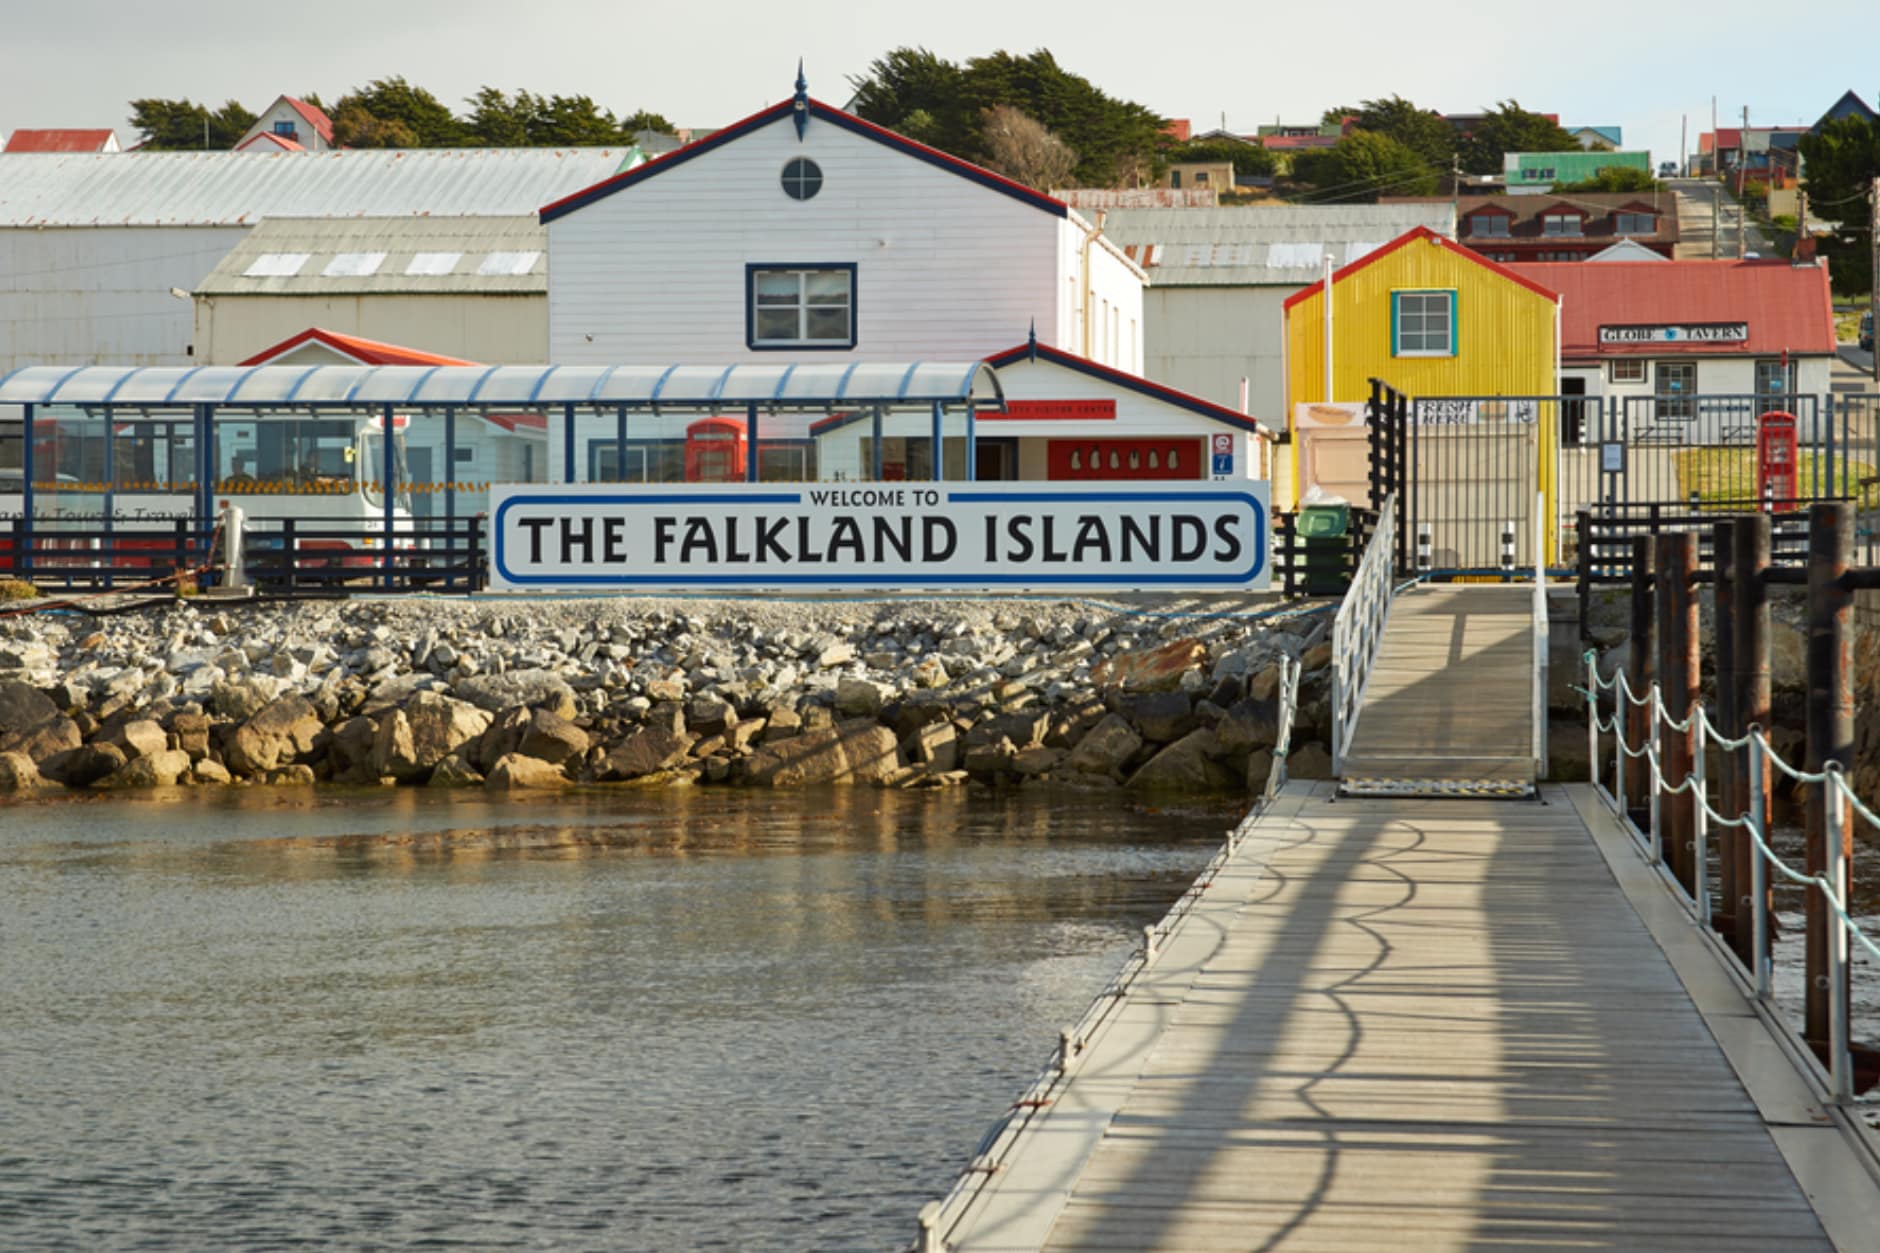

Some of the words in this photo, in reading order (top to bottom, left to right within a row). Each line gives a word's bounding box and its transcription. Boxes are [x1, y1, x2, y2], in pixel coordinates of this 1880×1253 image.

[1603, 327, 1655, 340] GLOBE
[1686, 325, 1742, 339] TAVERN
[810, 490, 905, 507] WELCOME
[913, 490, 939, 507] TO
[518, 516, 628, 564] THE
[653, 515, 959, 564] FALKLAND
[984, 514, 1242, 563] ISLANDS
